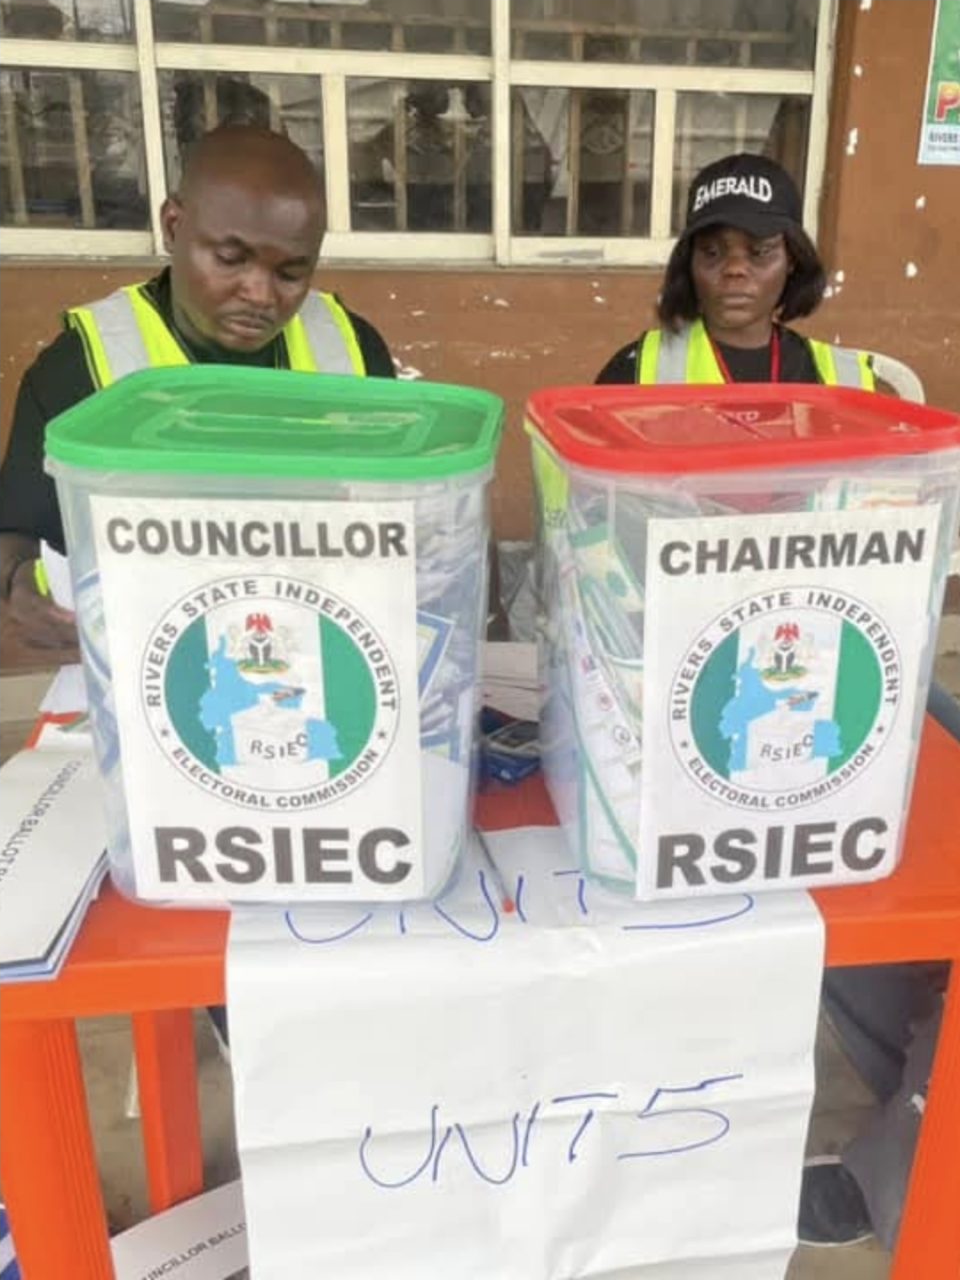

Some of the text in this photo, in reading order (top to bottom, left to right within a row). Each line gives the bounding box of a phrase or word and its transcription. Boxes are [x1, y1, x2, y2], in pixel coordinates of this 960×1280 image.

[692, 174, 773, 213] EMERALD
[106, 517, 409, 558] COUNCILLOR
[659, 528, 927, 577] CHAIRMAN
[146, 579, 397, 712] RIVERS STATE INDEPENDENT
[673, 591, 899, 721] RIVERS STATE INDEPENDENT
[250, 733, 309, 760] RSIEC
[688, 743, 876, 809] ELECTORAL COMMISSION
[760, 734, 814, 762] RSIEC
[172, 748, 380, 810] ELECTORAL COMMISSION
[154, 826, 413, 885] RSIEC
[655, 817, 889, 890] RSIEC
[359, 1074, 744, 1188] UNIT 5
